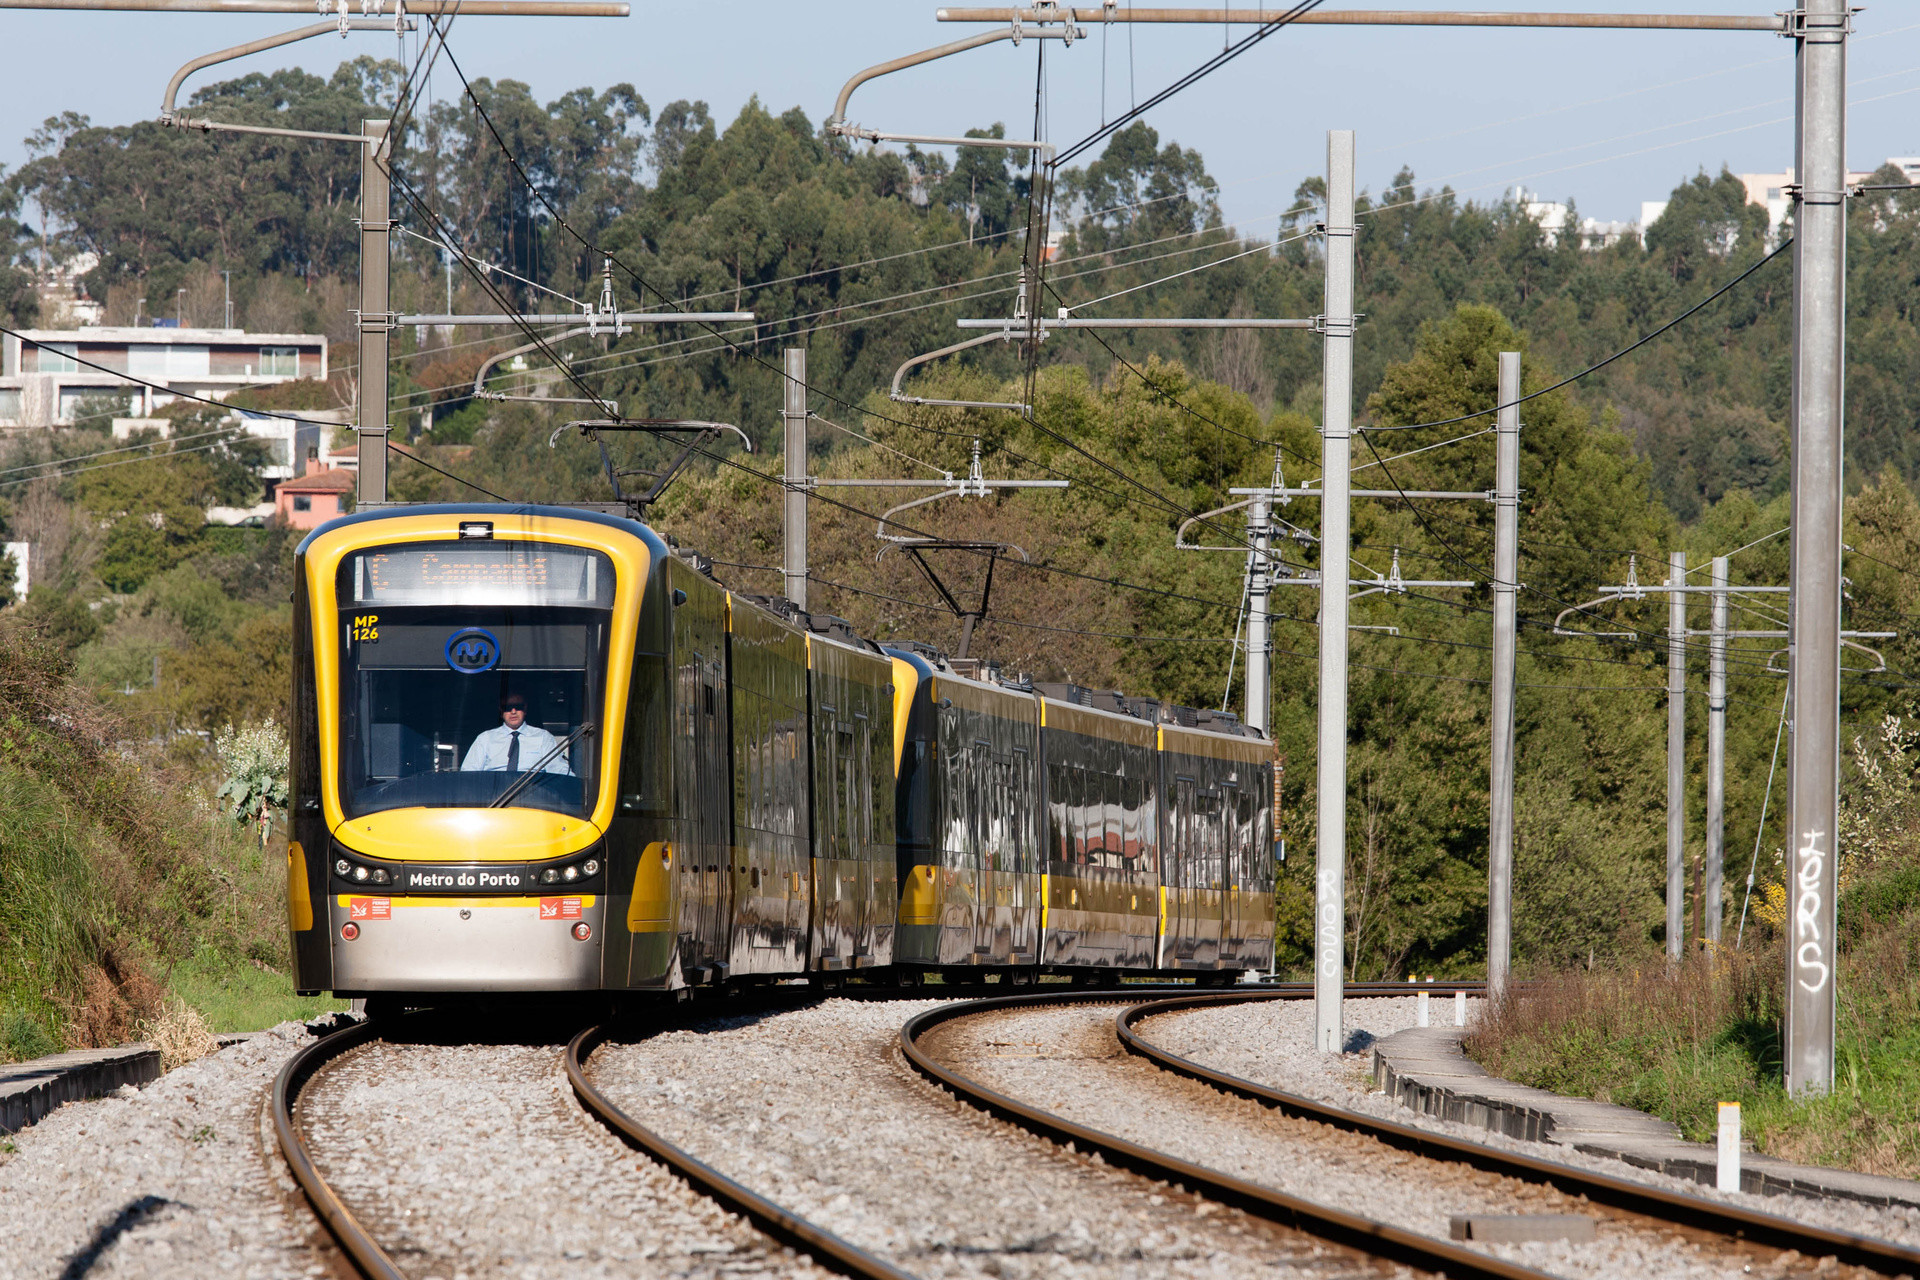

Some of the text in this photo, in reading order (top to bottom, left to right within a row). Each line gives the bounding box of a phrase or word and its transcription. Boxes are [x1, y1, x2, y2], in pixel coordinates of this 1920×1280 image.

[354, 615, 378, 628] MP
[352, 628, 379, 641] 126
[409, 872, 520, 887] Metro do Porto
